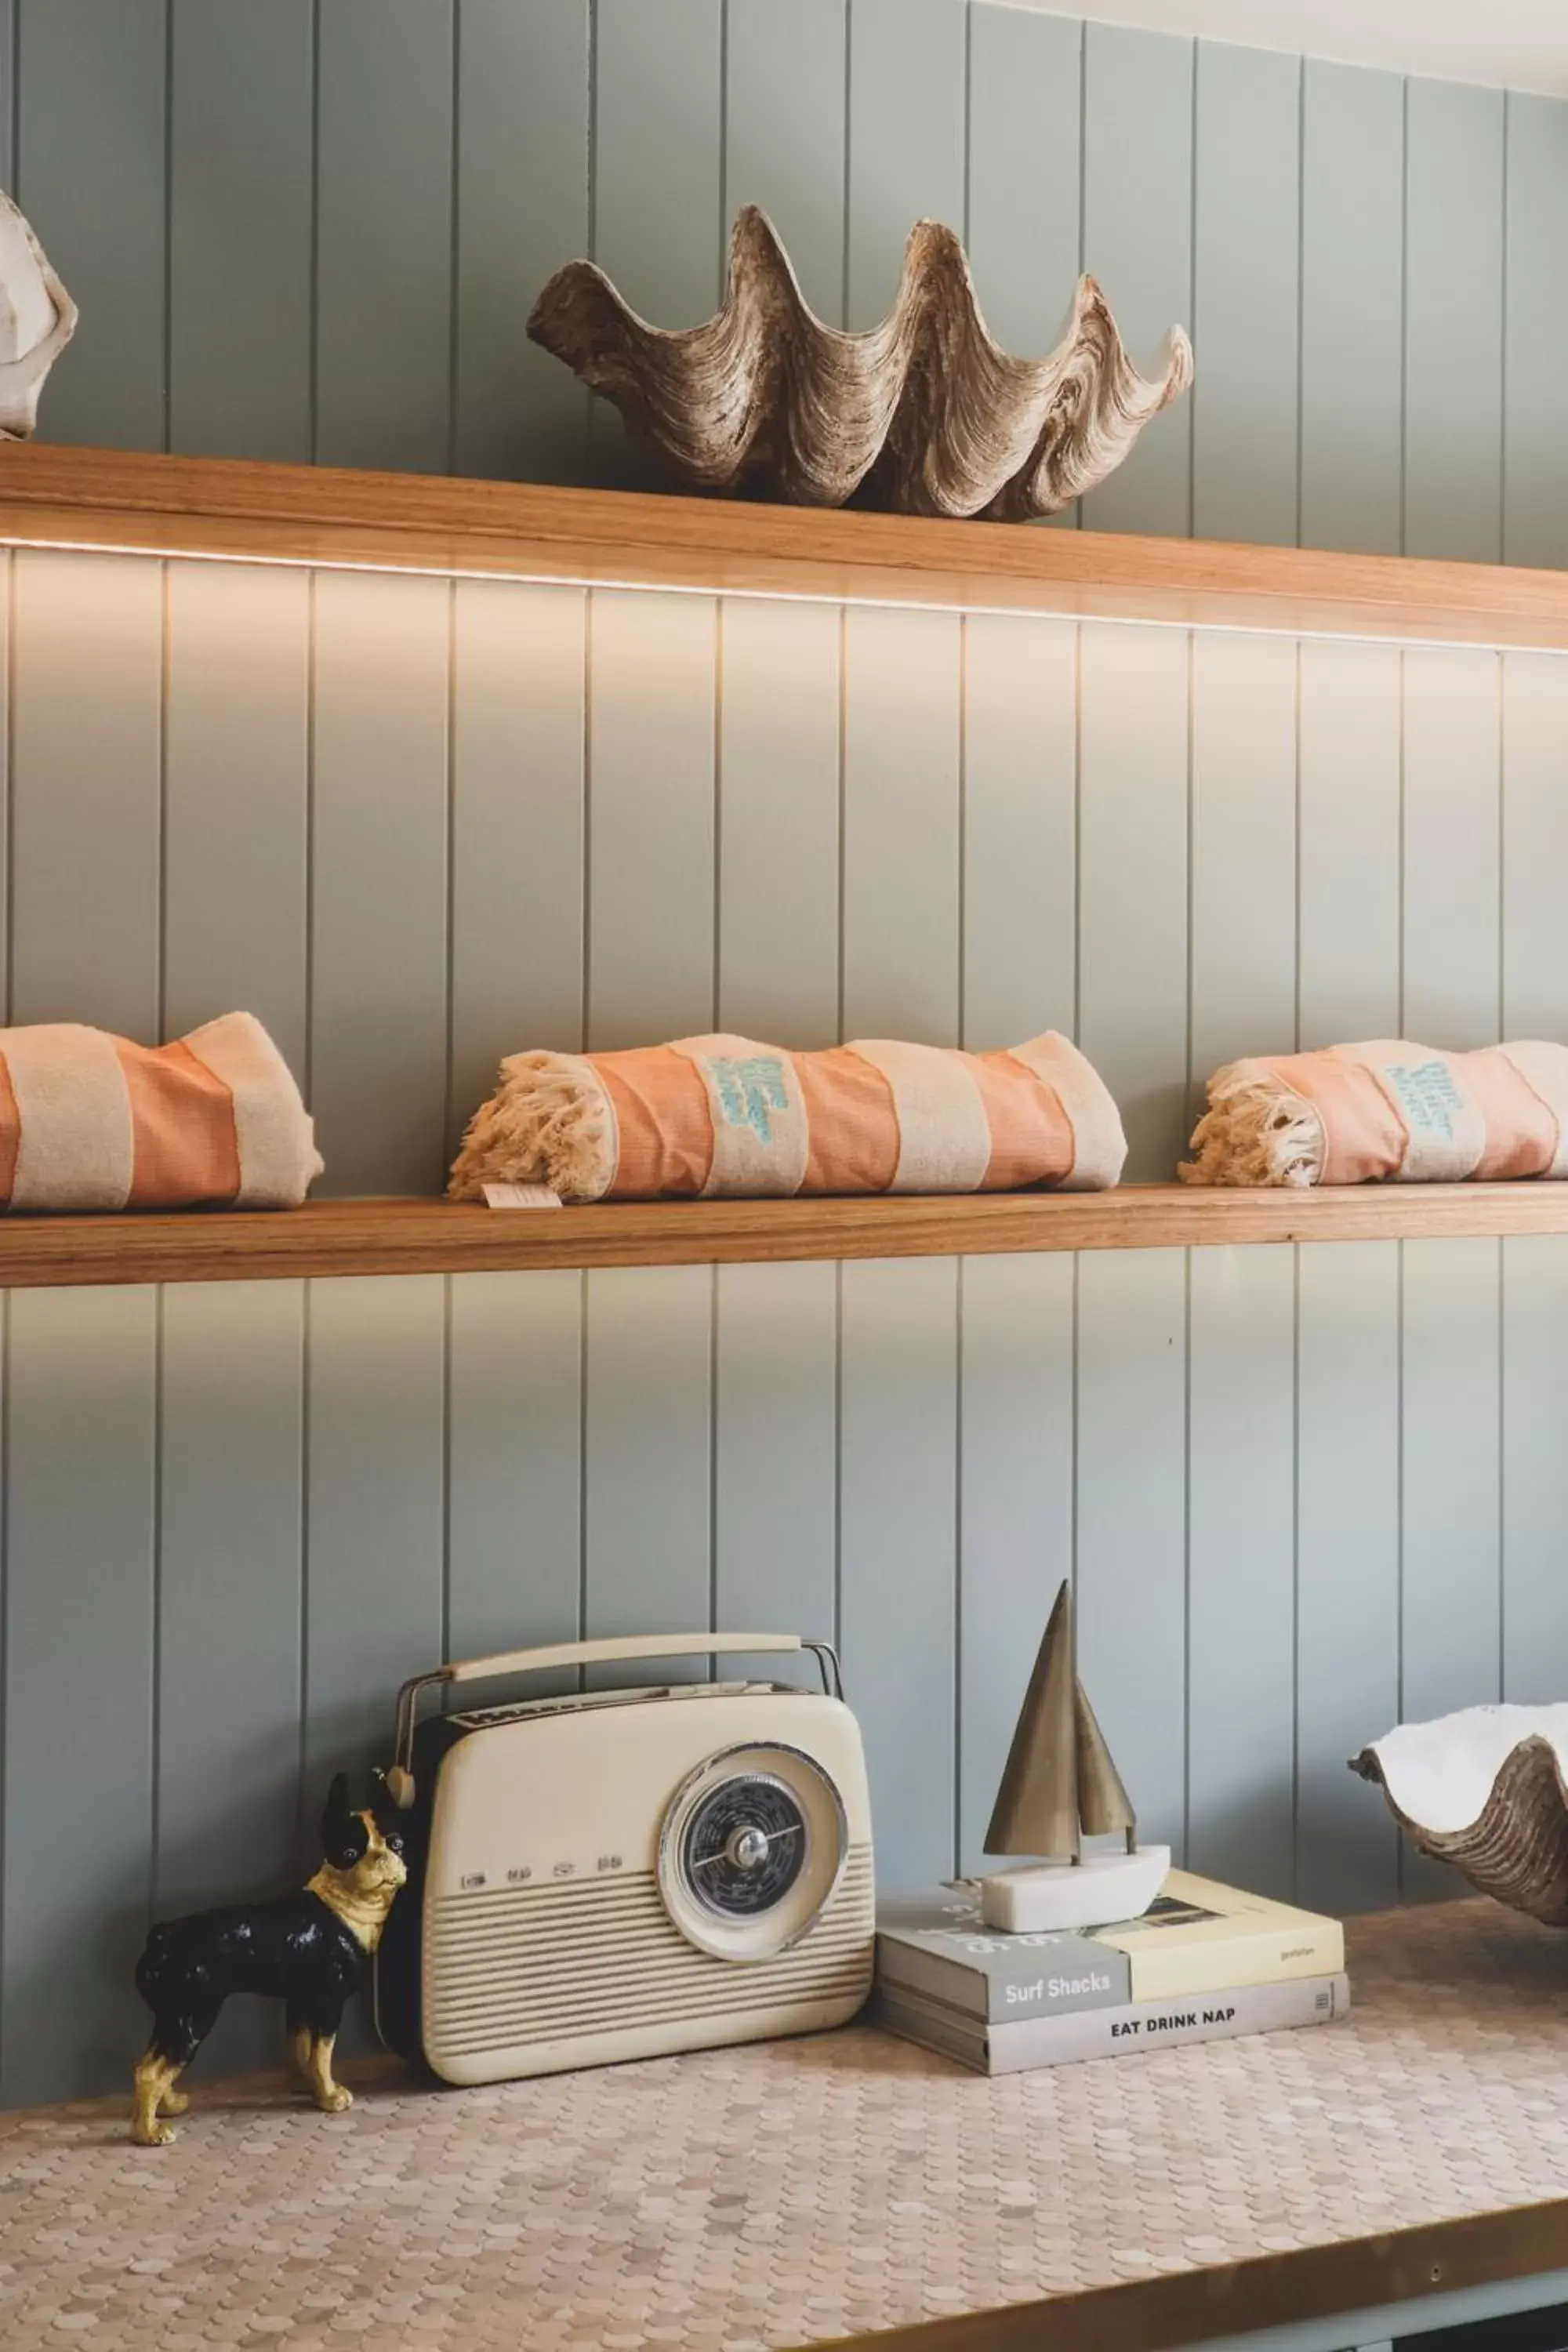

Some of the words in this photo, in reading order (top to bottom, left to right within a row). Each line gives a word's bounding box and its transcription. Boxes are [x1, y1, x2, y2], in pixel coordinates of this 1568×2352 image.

[1005, 1979, 1044, 2004] Surf
[1047, 1972, 1111, 1998] Shacks
[1110, 2021, 1142, 2038] EAT
[1147, 2013, 1197, 2033] DRINK
[1203, 2007, 1236, 2024] NAP
